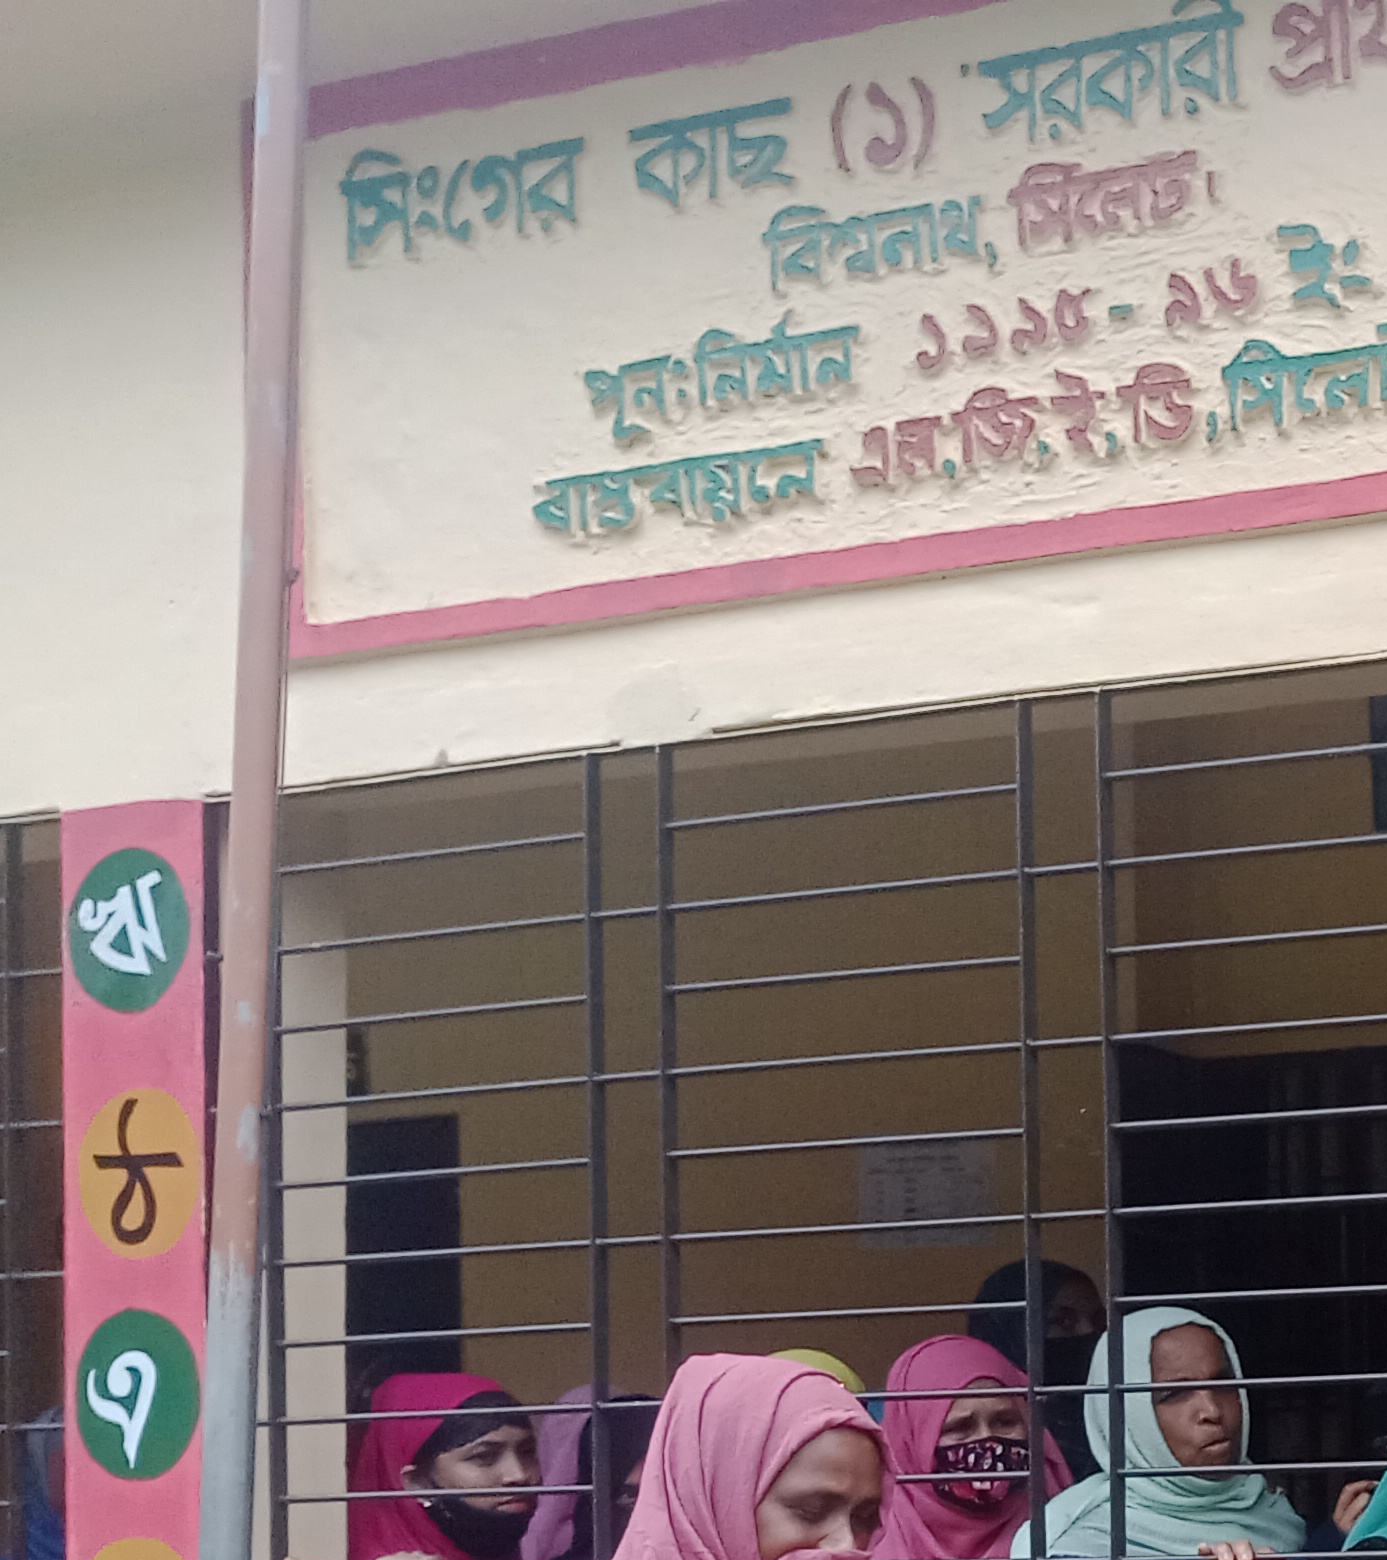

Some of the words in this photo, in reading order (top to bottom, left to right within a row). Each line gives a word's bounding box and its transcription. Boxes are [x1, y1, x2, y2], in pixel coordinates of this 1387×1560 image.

[629, 97, 795, 207] কাছ
[831, 76, 935, 173] (১)
[93, 1098, 185, 1245] ঠ
[87, 1350, 157, 1470] এ
